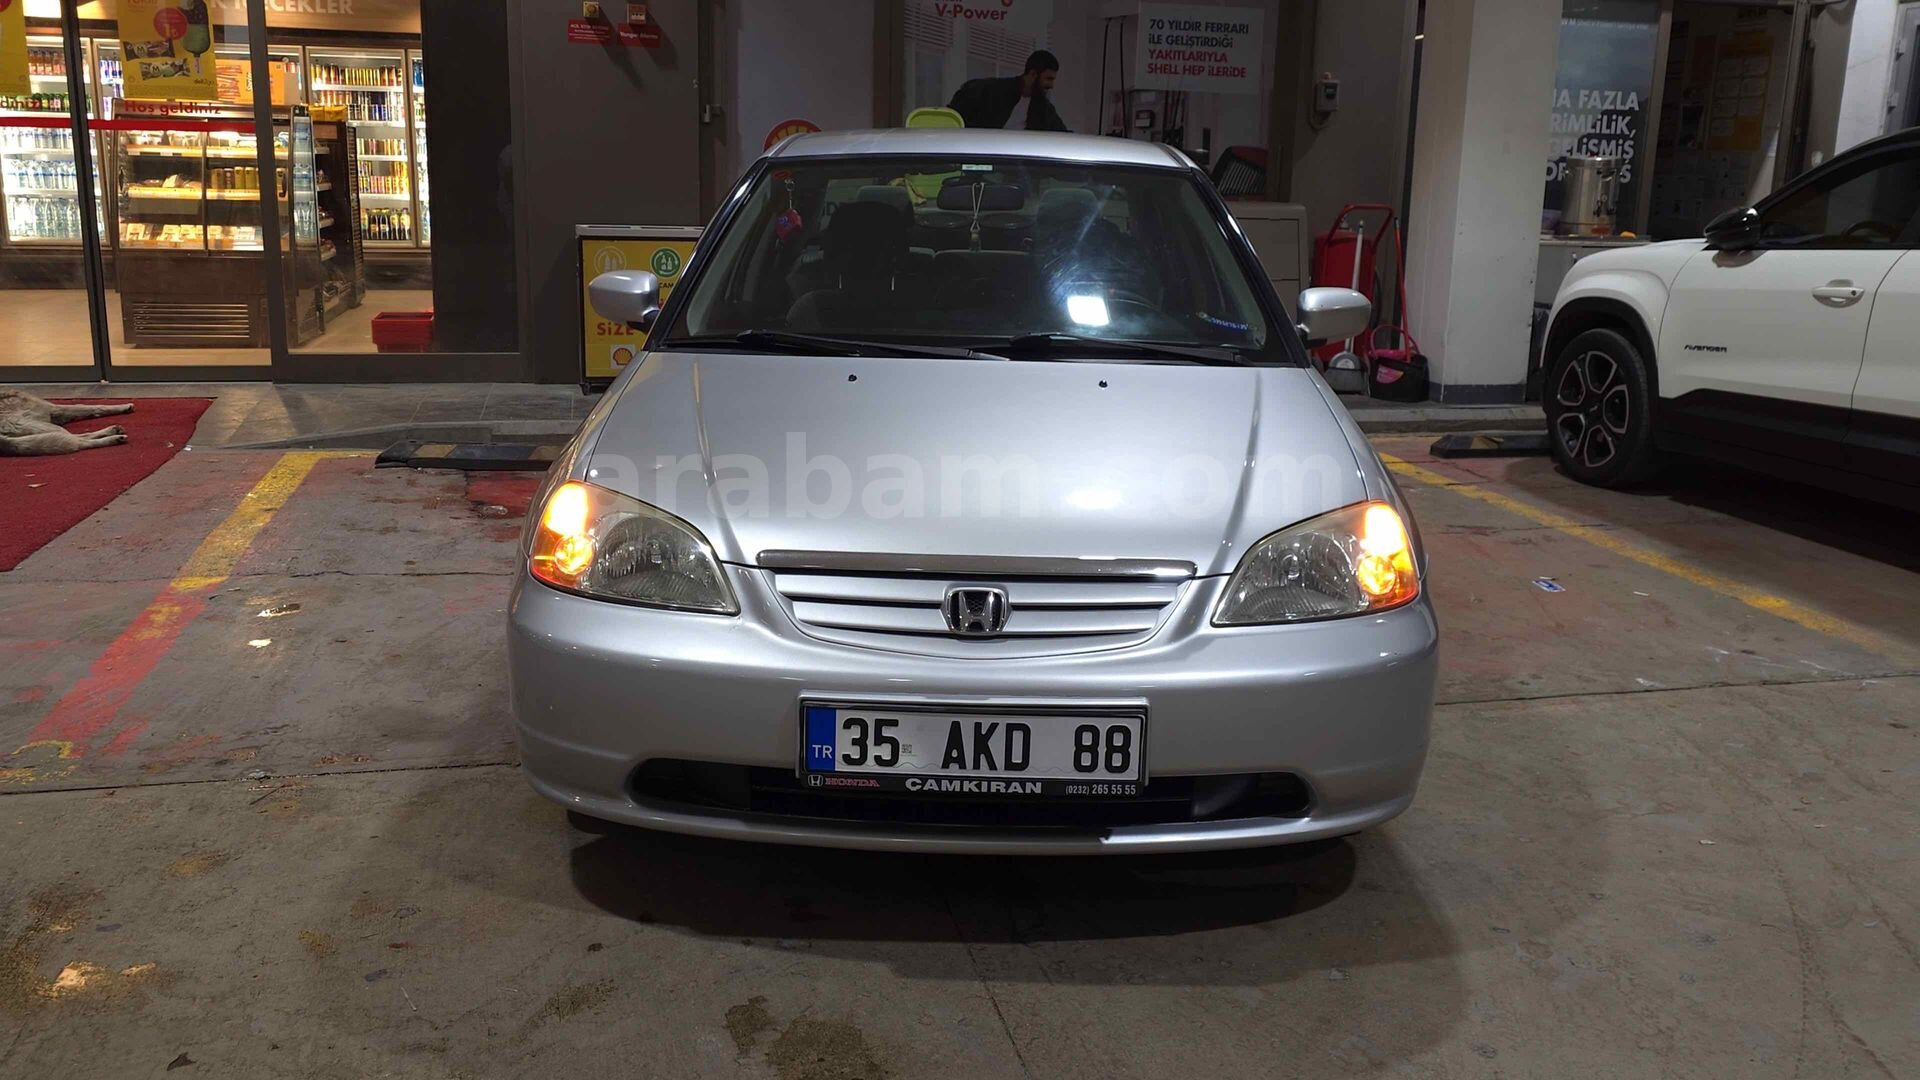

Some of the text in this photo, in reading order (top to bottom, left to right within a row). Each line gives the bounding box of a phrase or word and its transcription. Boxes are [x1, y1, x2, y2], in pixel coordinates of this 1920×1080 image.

[934, 3, 1008, 20] V-Power
[1149, 19, 1249, 34] 70 YILDIR FERRARI
[1148, 49, 1228, 63] YAKITLARIYLA
[1147, 63, 1180, 75] SHELL
[1183, 65, 1205, 76] HEP
[1578, 89, 1639, 111] FAZLA
[160, 101, 222, 117] geldiniz
[1683, 344, 1728, 353] AVENGER
[812, 744, 834, 759] TR
[841, 717, 1133, 774] 35 AKD 88
[825, 777, 880, 787] HONDA
[1065, 784, 1137, 796] (0232) 265 55 55
